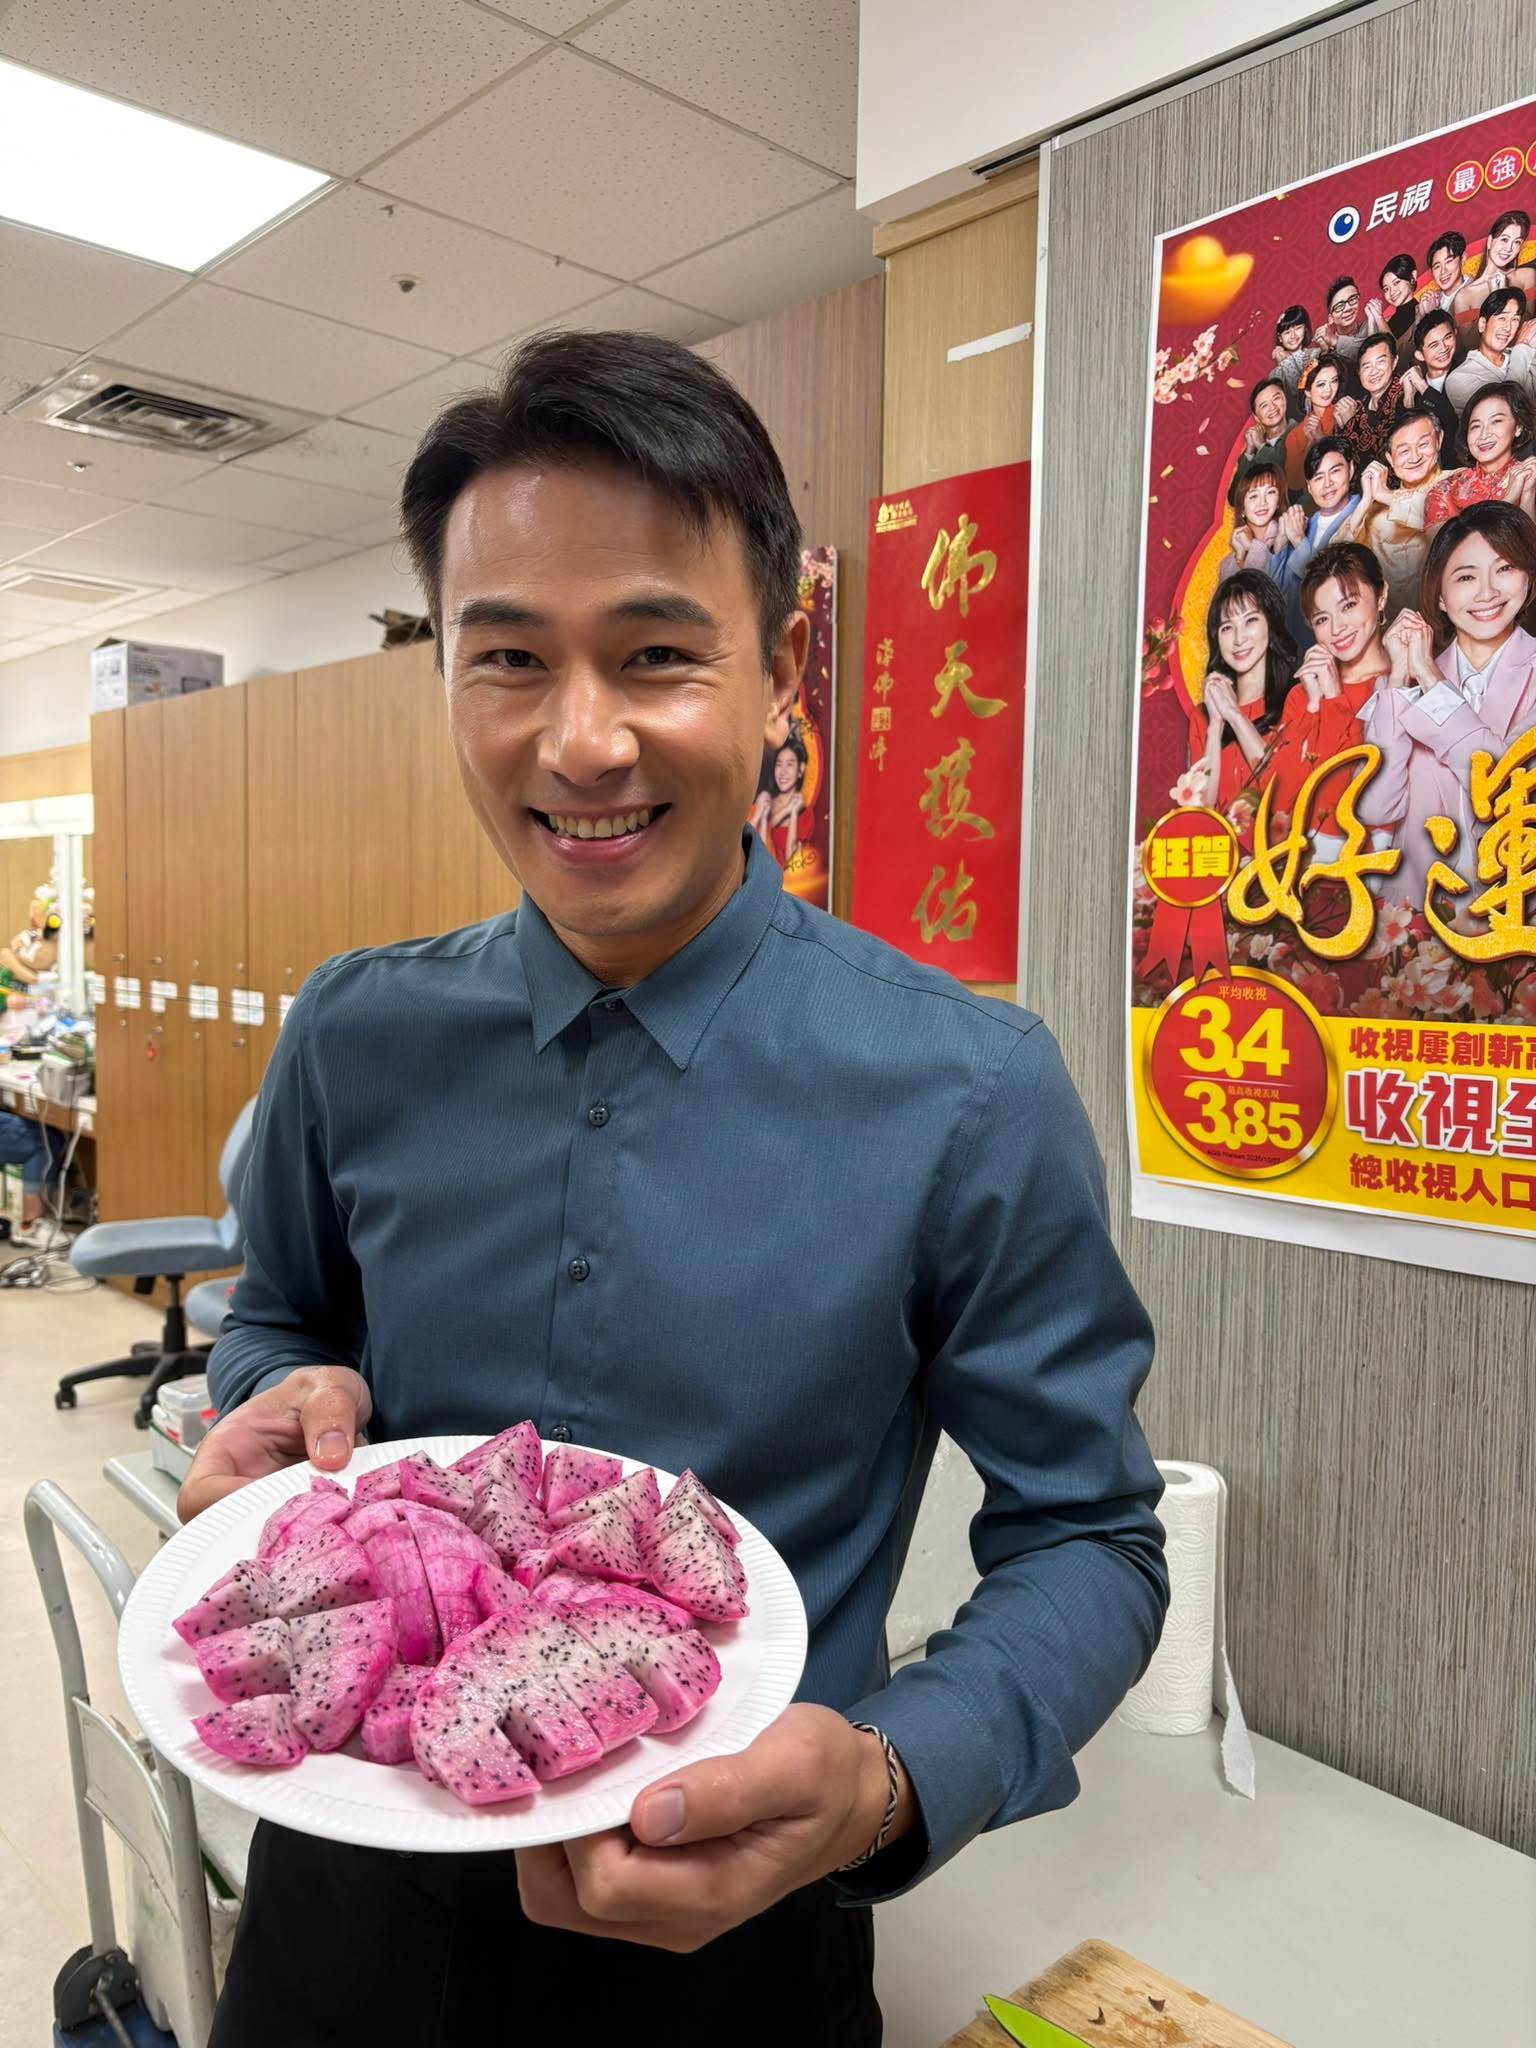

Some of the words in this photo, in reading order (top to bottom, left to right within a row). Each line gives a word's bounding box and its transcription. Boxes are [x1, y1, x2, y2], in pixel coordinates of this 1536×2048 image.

[1453, 154, 1536, 195] 最強
[1366, 179, 1433, 231] 民視
[1151, 835, 1230, 879] 狂賀
[1218, 984, 1268, 1001] 平均收視
[1179, 995, 1290, 1078] 3.4
[1349, 1026, 1536, 1070] 收視屢創新
[1184, 1080, 1303, 1150] 3.85
[1349, 1153, 1536, 1211] 總收視人口
